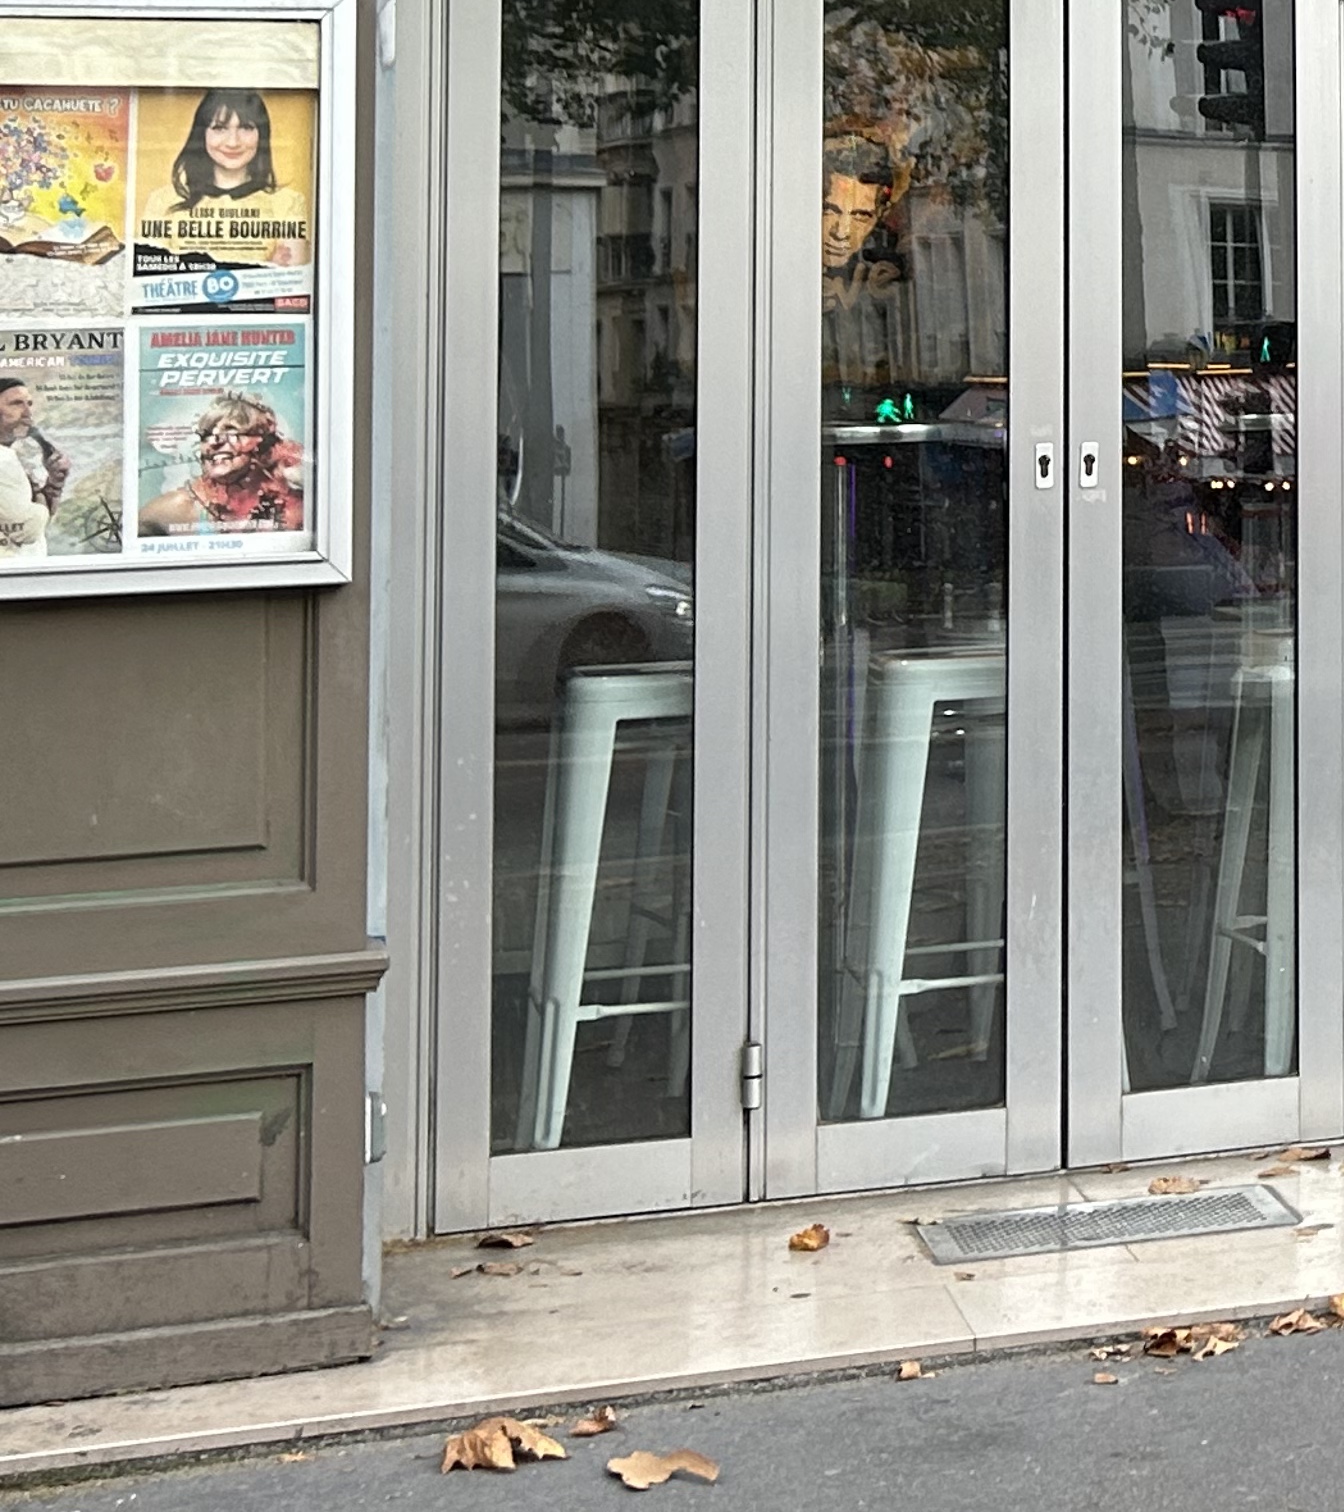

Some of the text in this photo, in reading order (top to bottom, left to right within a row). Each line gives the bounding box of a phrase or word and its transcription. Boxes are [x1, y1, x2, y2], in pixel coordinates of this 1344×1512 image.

[141, 220, 307, 239] UNE BELLE BOURRINE
[142, 277, 198, 299] THÉÂTRE
[206, 275, 234, 294] BO
[14, 330, 124, 352] BRYANT
[151, 332, 202, 348] AMELIA
[241, 329, 296, 346] HUNTER
[157, 350, 288, 369] EXQUISITE
[160, 367, 289, 388] PERVERT
